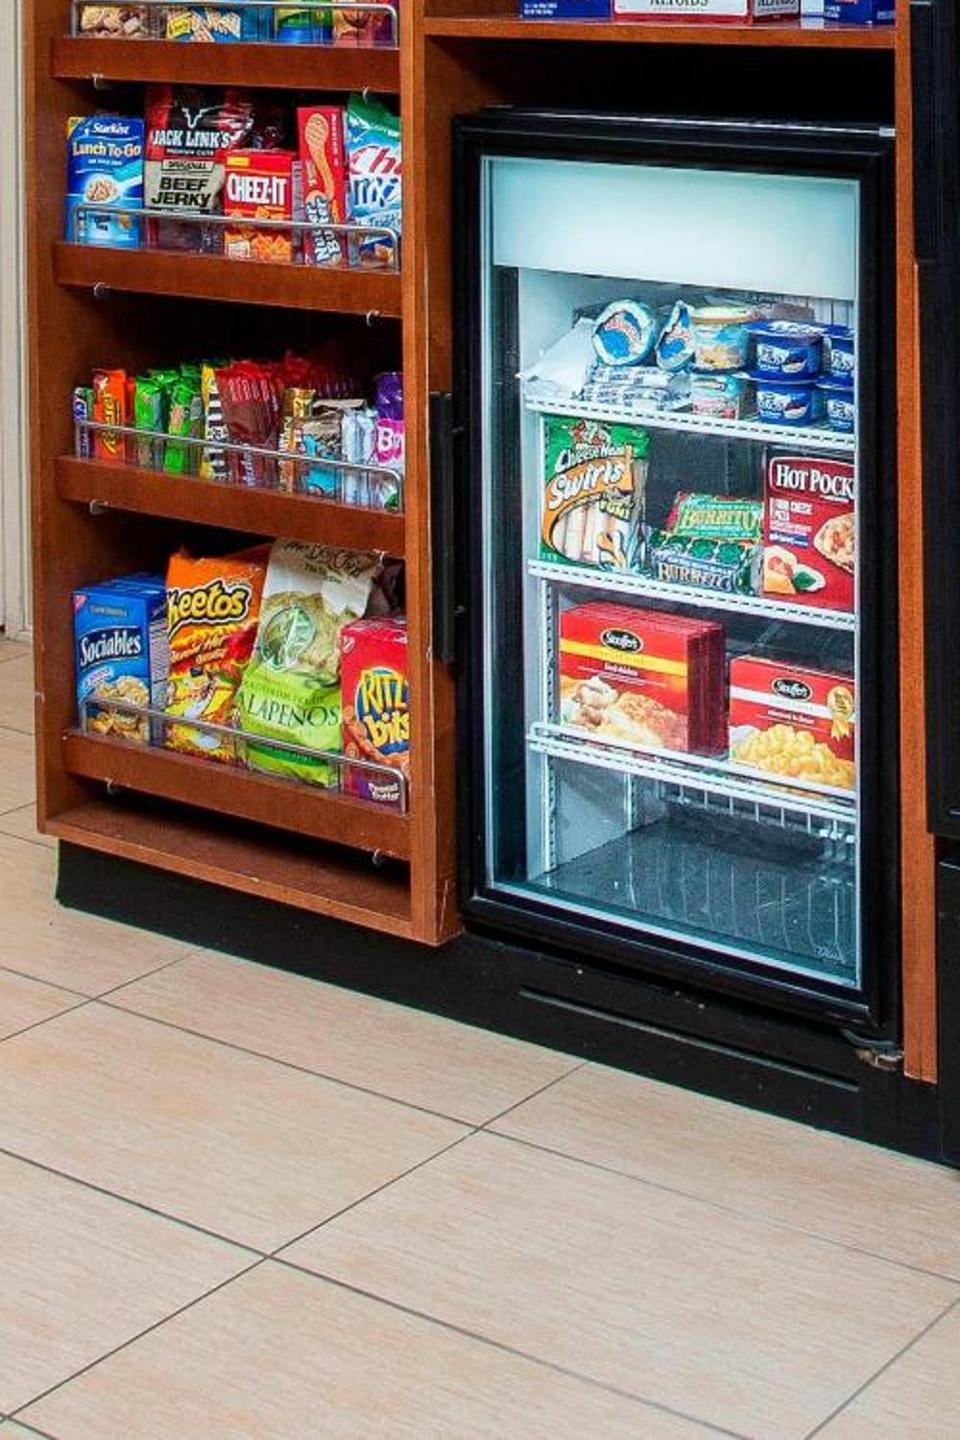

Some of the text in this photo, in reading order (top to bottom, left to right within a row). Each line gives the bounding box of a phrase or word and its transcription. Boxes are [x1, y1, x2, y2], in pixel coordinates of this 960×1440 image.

[72, 141, 143, 158] Lunch To-Go
[153, 129, 231, 149] JACK LINK'S
[160, 176, 210, 192] BEEF
[226, 172, 287, 206] CHEEZ-IT
[151, 191, 213, 208] JERKY
[776, 463, 854, 500] HOT POCK
[167, 581, 250, 624] heetos
[80, 626, 143, 667] Sociables
